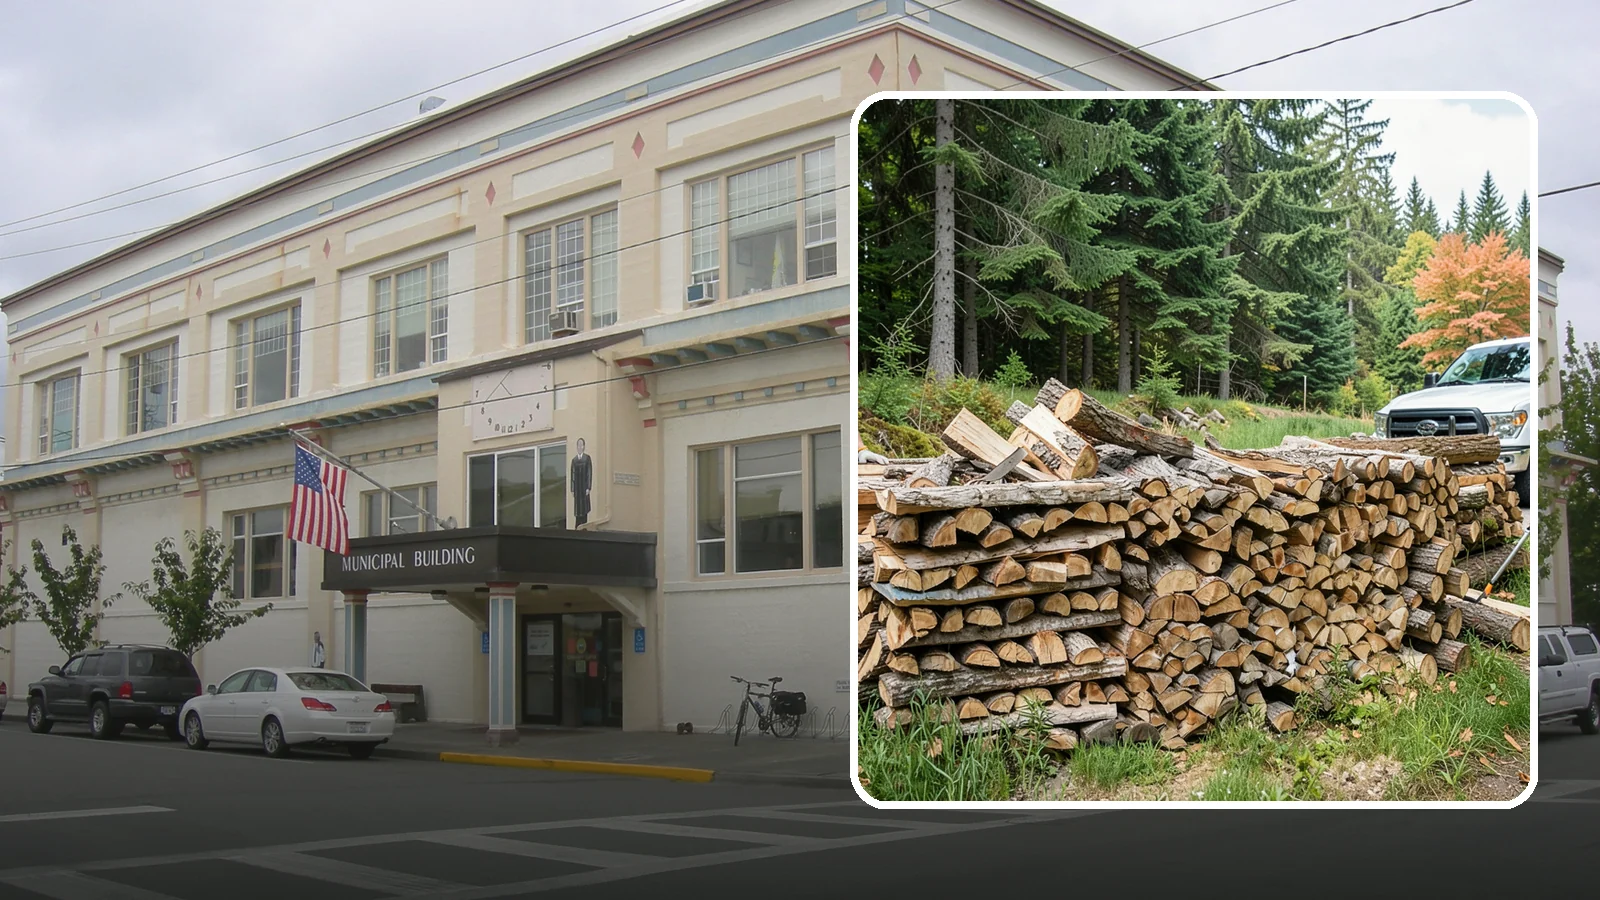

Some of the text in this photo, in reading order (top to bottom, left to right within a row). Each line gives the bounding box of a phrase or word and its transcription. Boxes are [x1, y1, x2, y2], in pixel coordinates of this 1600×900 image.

[475, 390, 479, 398] 7
[481, 407, 485, 415] 8
[488, 417, 492, 426] 9
[494, 423, 500, 432] 10
[501, 425, 506, 433] 11
[507, 425, 513, 433] 12
[521, 420, 526, 428] 2
[529, 414, 533, 422] 3
[536, 402, 540, 410] 4
[342, 546, 475, 571] MUNICIPAL BUILDING
